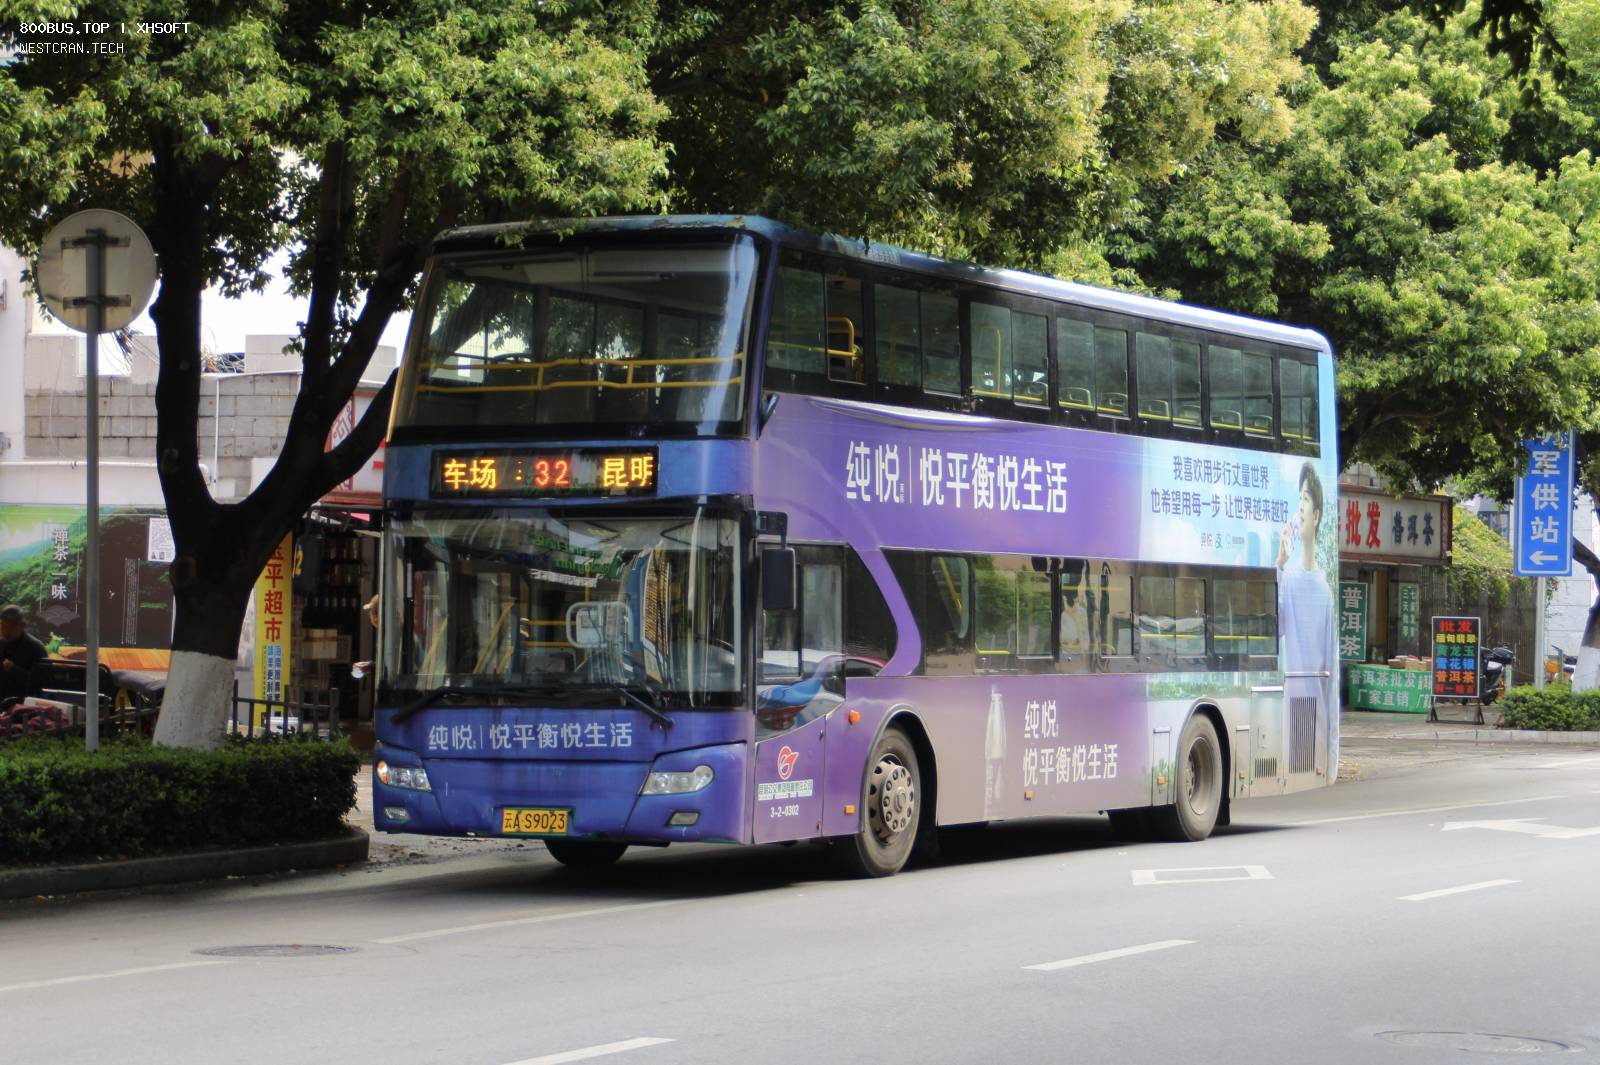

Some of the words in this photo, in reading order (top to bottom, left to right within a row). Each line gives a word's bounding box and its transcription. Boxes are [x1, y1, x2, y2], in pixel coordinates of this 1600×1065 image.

[444, 458, 497, 489] 车场
[535, 460, 569, 485] 32
[603, 456, 654, 487] 昆明
[846, 440, 900, 503] 纯悦
[919, 447, 1068, 514] 悦平衡悦生活
[1173, 455, 1270, 490] 我喜欢用步行丈量世界
[1150, 488, 1221, 519] 也希望用每一步
[1224, 494, 1289, 523] 让世界越来越好
[1338, 499, 1381, 549] 批发
[1341, 587, 1363, 656] 普洱茶
[1350, 670, 1416, 688] 普洱茶批发
[428, 725, 472, 750] 纯悦
[489, 722, 632, 749] 悦平衡悦生活
[1024, 700, 1056, 738] 纯悦
[1023, 744, 1117, 786] 悦平衡悦生活
